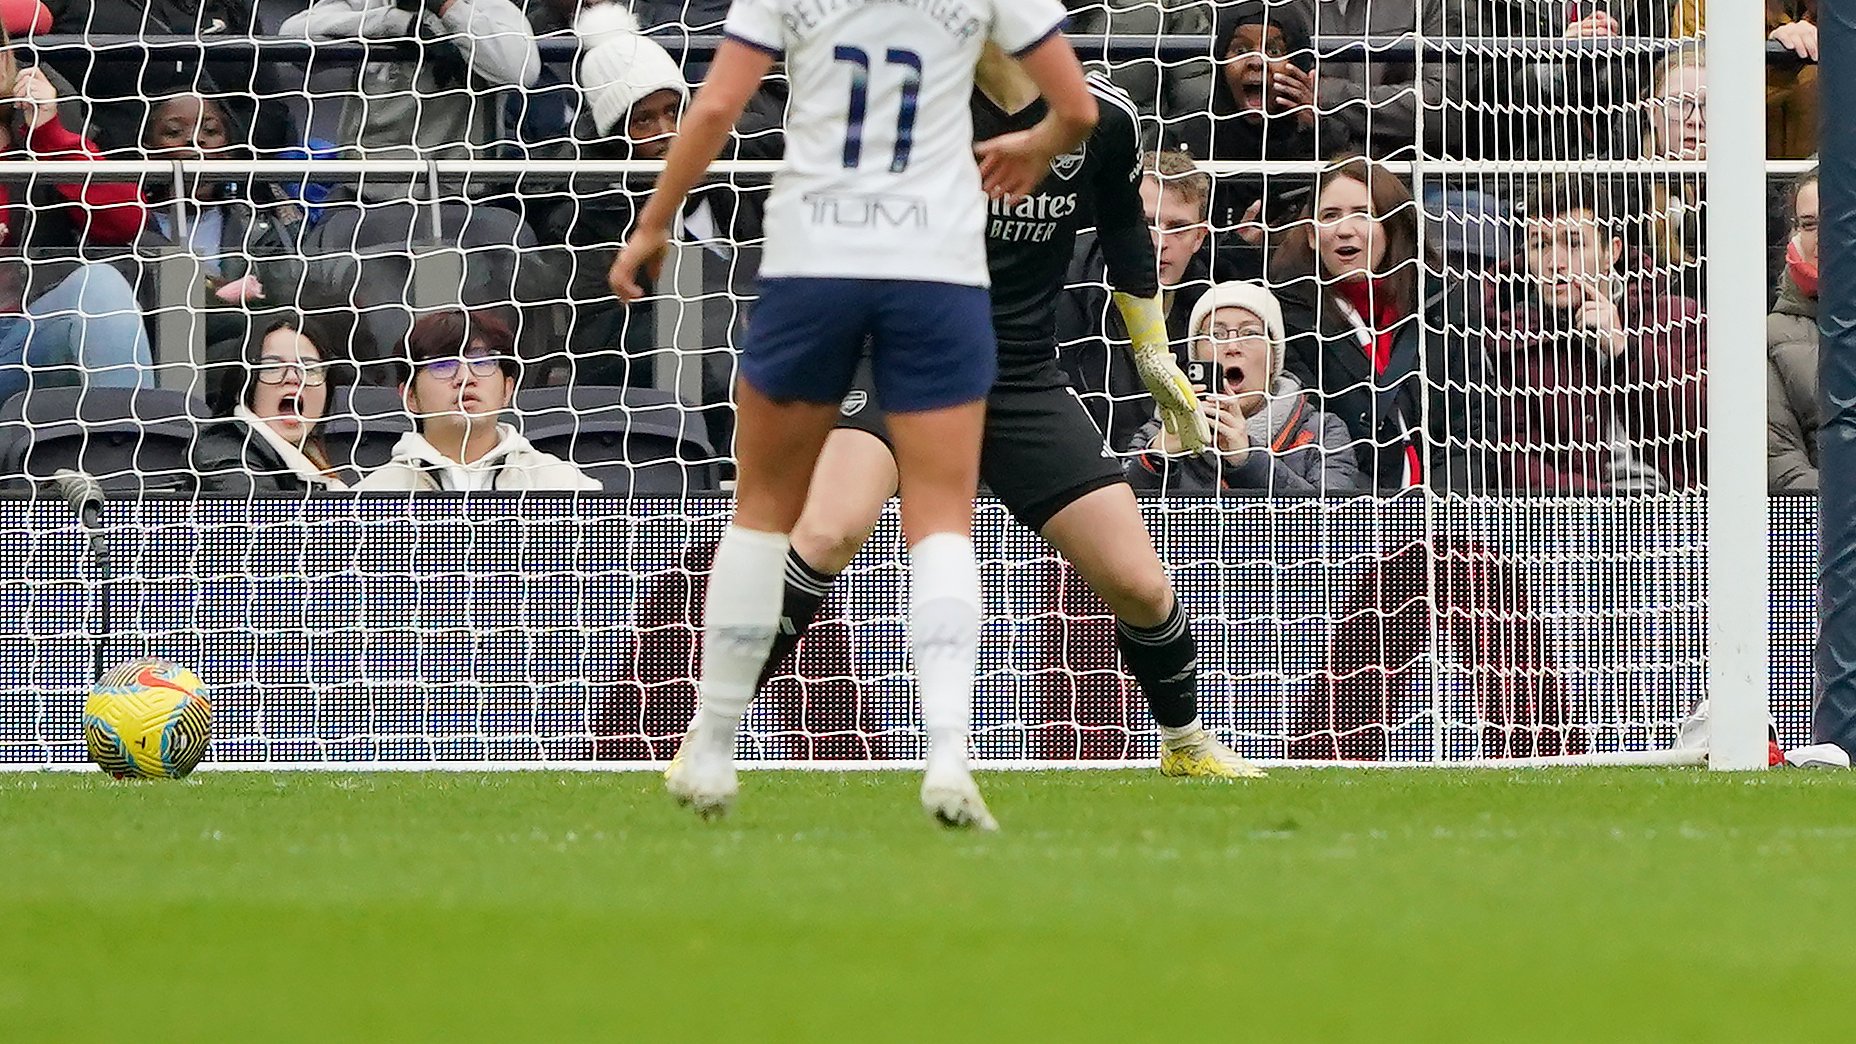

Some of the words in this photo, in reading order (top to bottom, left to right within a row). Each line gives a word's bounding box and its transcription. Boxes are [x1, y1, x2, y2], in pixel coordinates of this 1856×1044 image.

[833, 44, 923, 174] 11
[800, 190, 930, 232] TUMI
[989, 219, 1058, 243] BETTER
